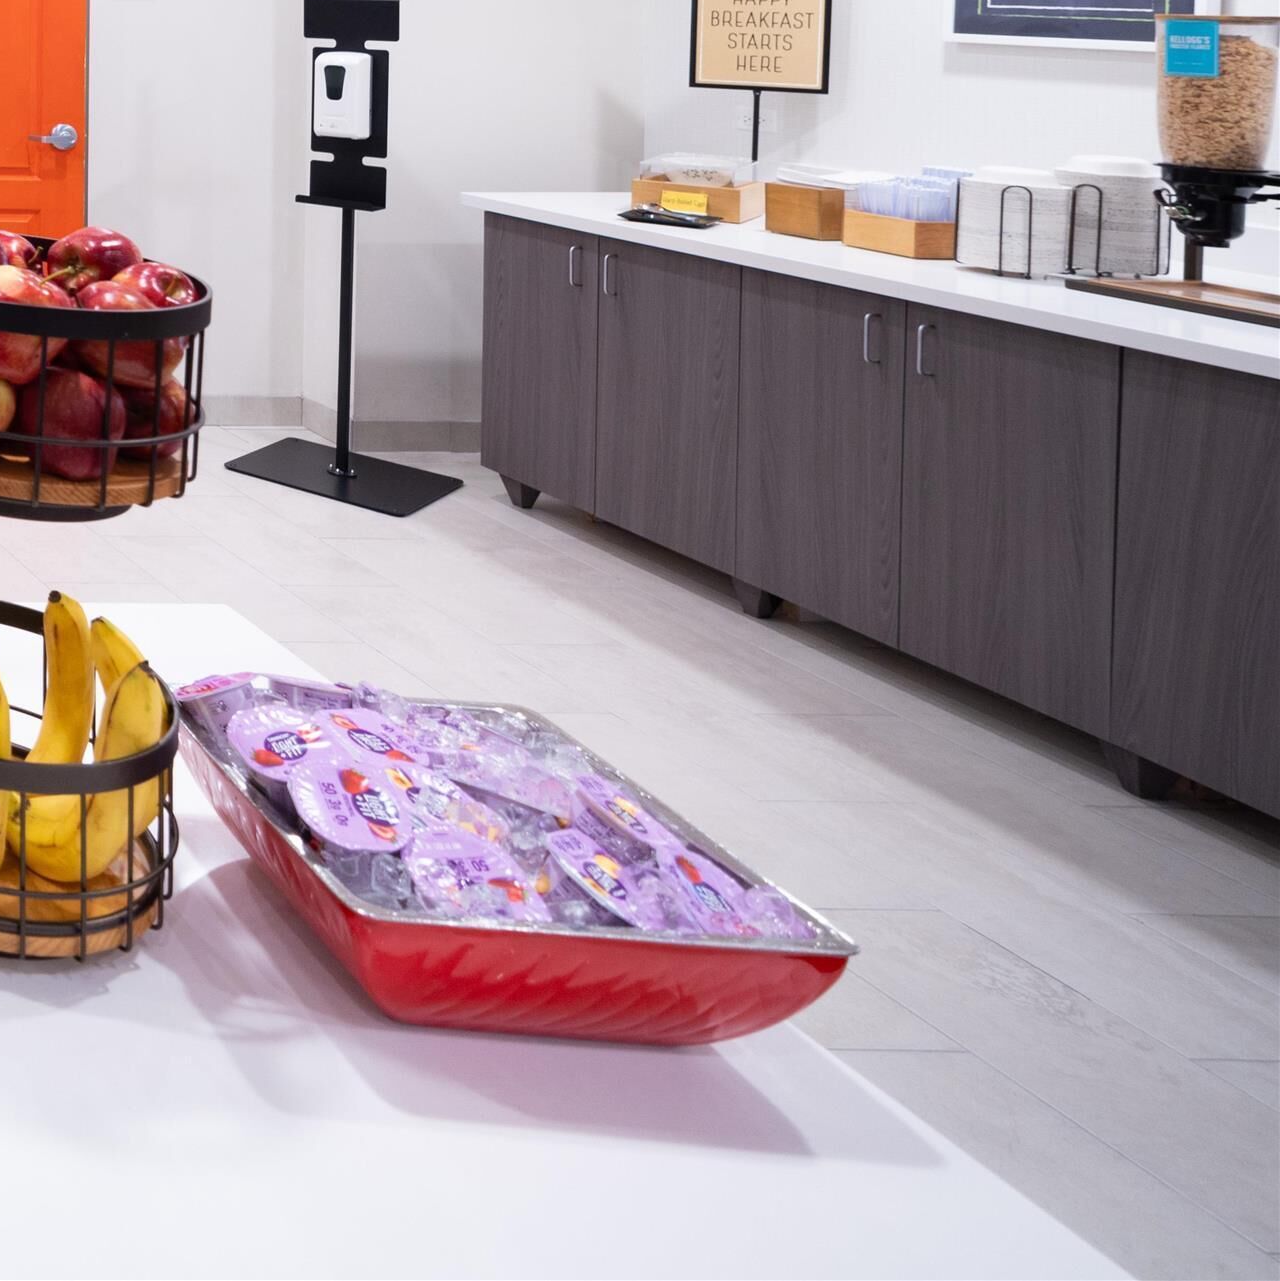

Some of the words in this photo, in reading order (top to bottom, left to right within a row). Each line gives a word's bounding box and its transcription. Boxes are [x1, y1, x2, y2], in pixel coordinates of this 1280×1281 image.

[710, 10, 815, 29] BREAKFAST
[727, 32, 794, 52] STARTS
[736, 55, 783, 73] HERE
